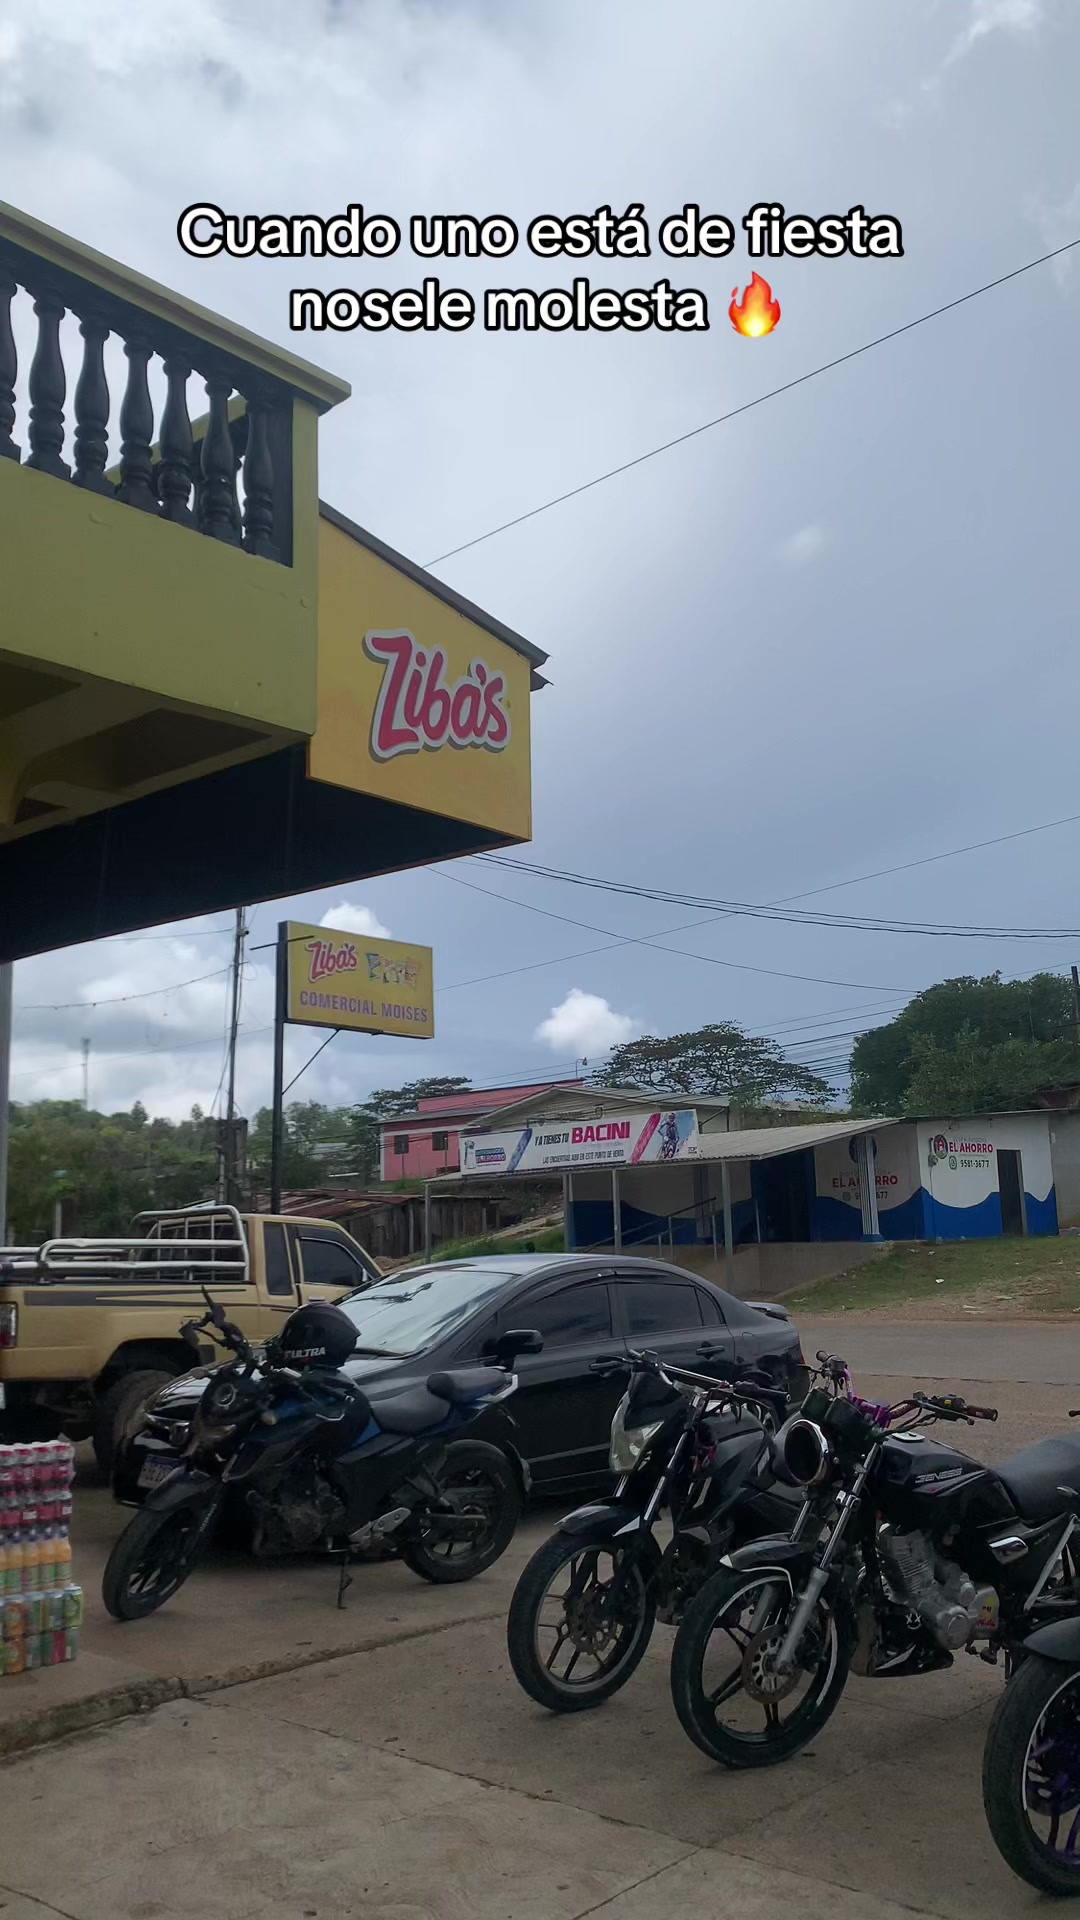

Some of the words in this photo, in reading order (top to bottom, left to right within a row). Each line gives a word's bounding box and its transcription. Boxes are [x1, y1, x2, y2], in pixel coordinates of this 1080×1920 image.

[367, 631, 509, 755] Ziba's
[305, 940, 358, 982] Ziba's
[300, 990, 377, 1016] COMERCIAL
[381, 1003, 428, 1023] MOISES
[571, 1121, 631, 1144] BACINI
[949, 1142, 958, 1152] EL
[960, 1142, 993, 1153] AHORRO
[832, 1177, 845, 1188] EL
[848, 1175, 898, 1187] ARRO
